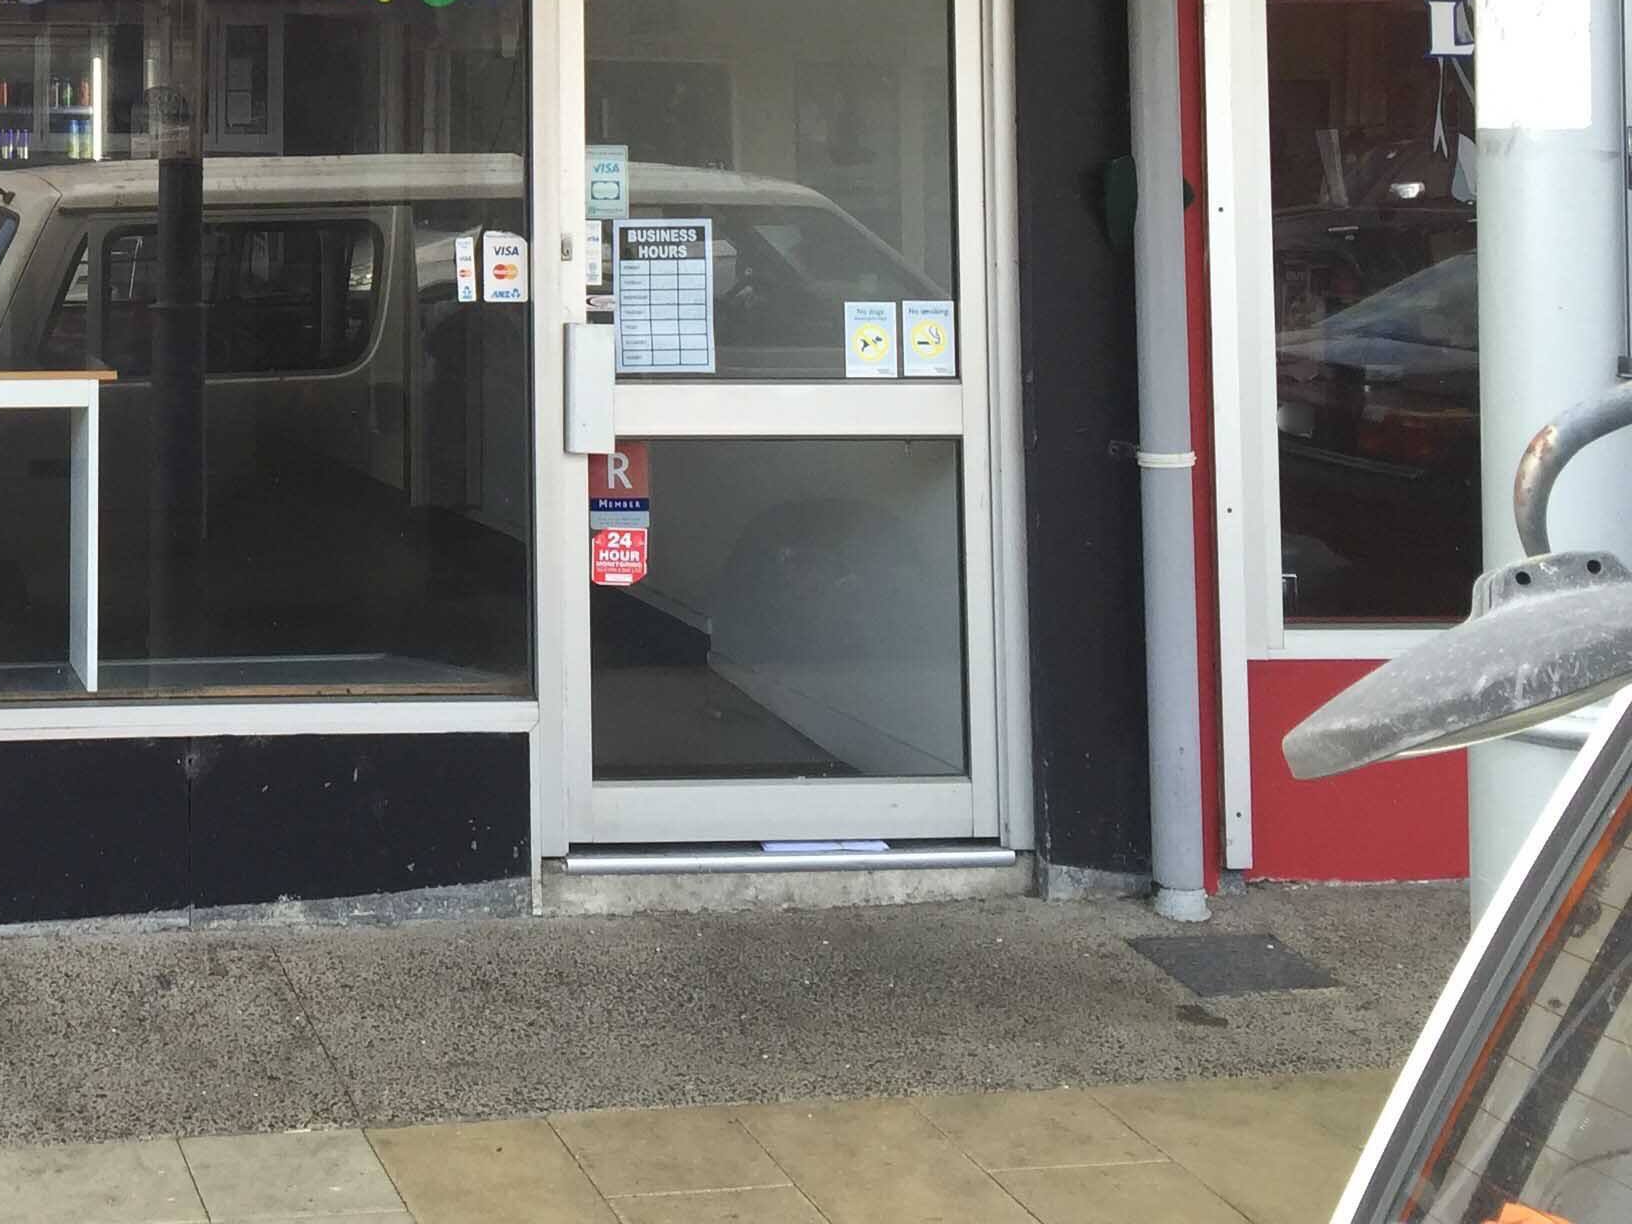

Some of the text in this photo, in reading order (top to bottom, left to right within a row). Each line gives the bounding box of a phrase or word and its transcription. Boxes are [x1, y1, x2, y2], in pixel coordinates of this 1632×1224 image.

[592, 162, 621, 174] VISA
[627, 229, 697, 243] BUSINESS
[493, 245, 520, 256] VISA
[638, 245, 688, 259] HOURS
[607, 451, 633, 489] R
[607, 531, 632, 549] 24
[598, 549, 640, 562] HOUR
